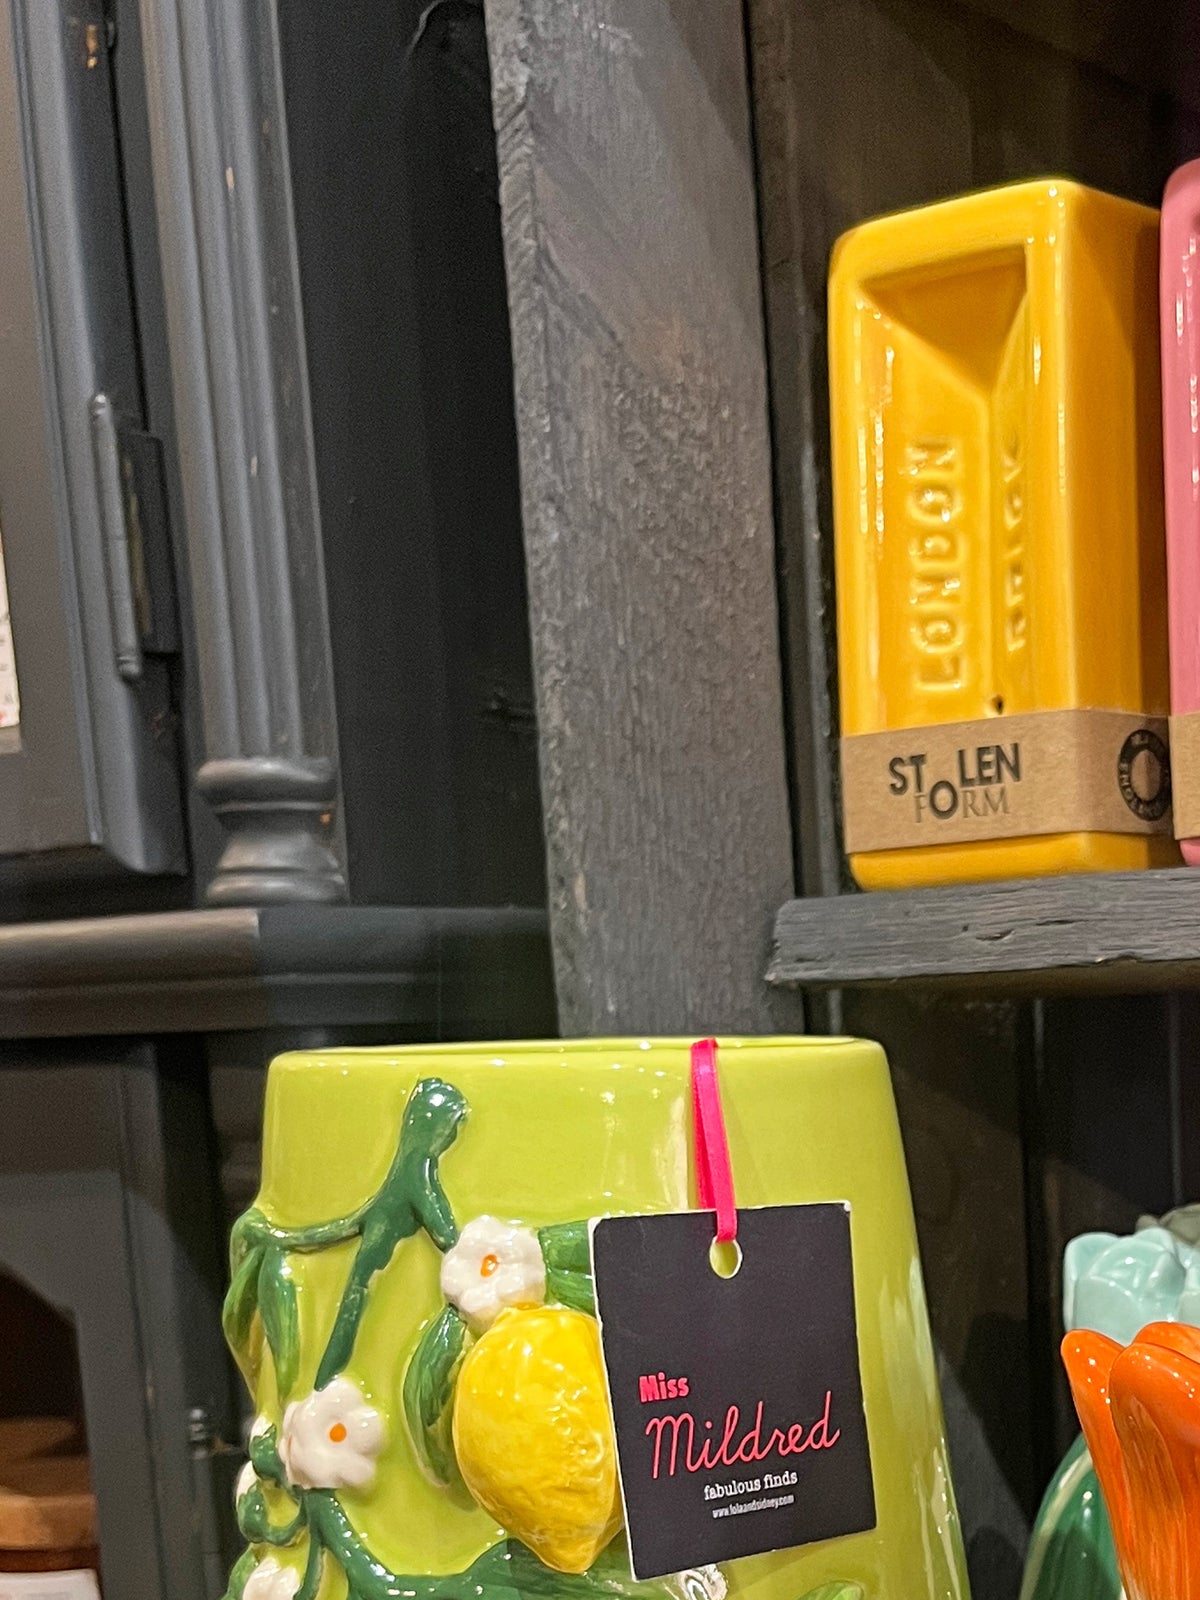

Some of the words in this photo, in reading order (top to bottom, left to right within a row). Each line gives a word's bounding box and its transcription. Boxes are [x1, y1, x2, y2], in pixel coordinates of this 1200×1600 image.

[903, 438, 966, 692] LONDON
[889, 742, 1021, 819] STOLEN
[913, 780, 1011, 823] FORM
[639, 1371, 690, 1403] Miss
[645, 1390, 842, 1480] Mildred
[704, 1478, 761, 1501] fabulous
[763, 1470, 799, 1490] finds
